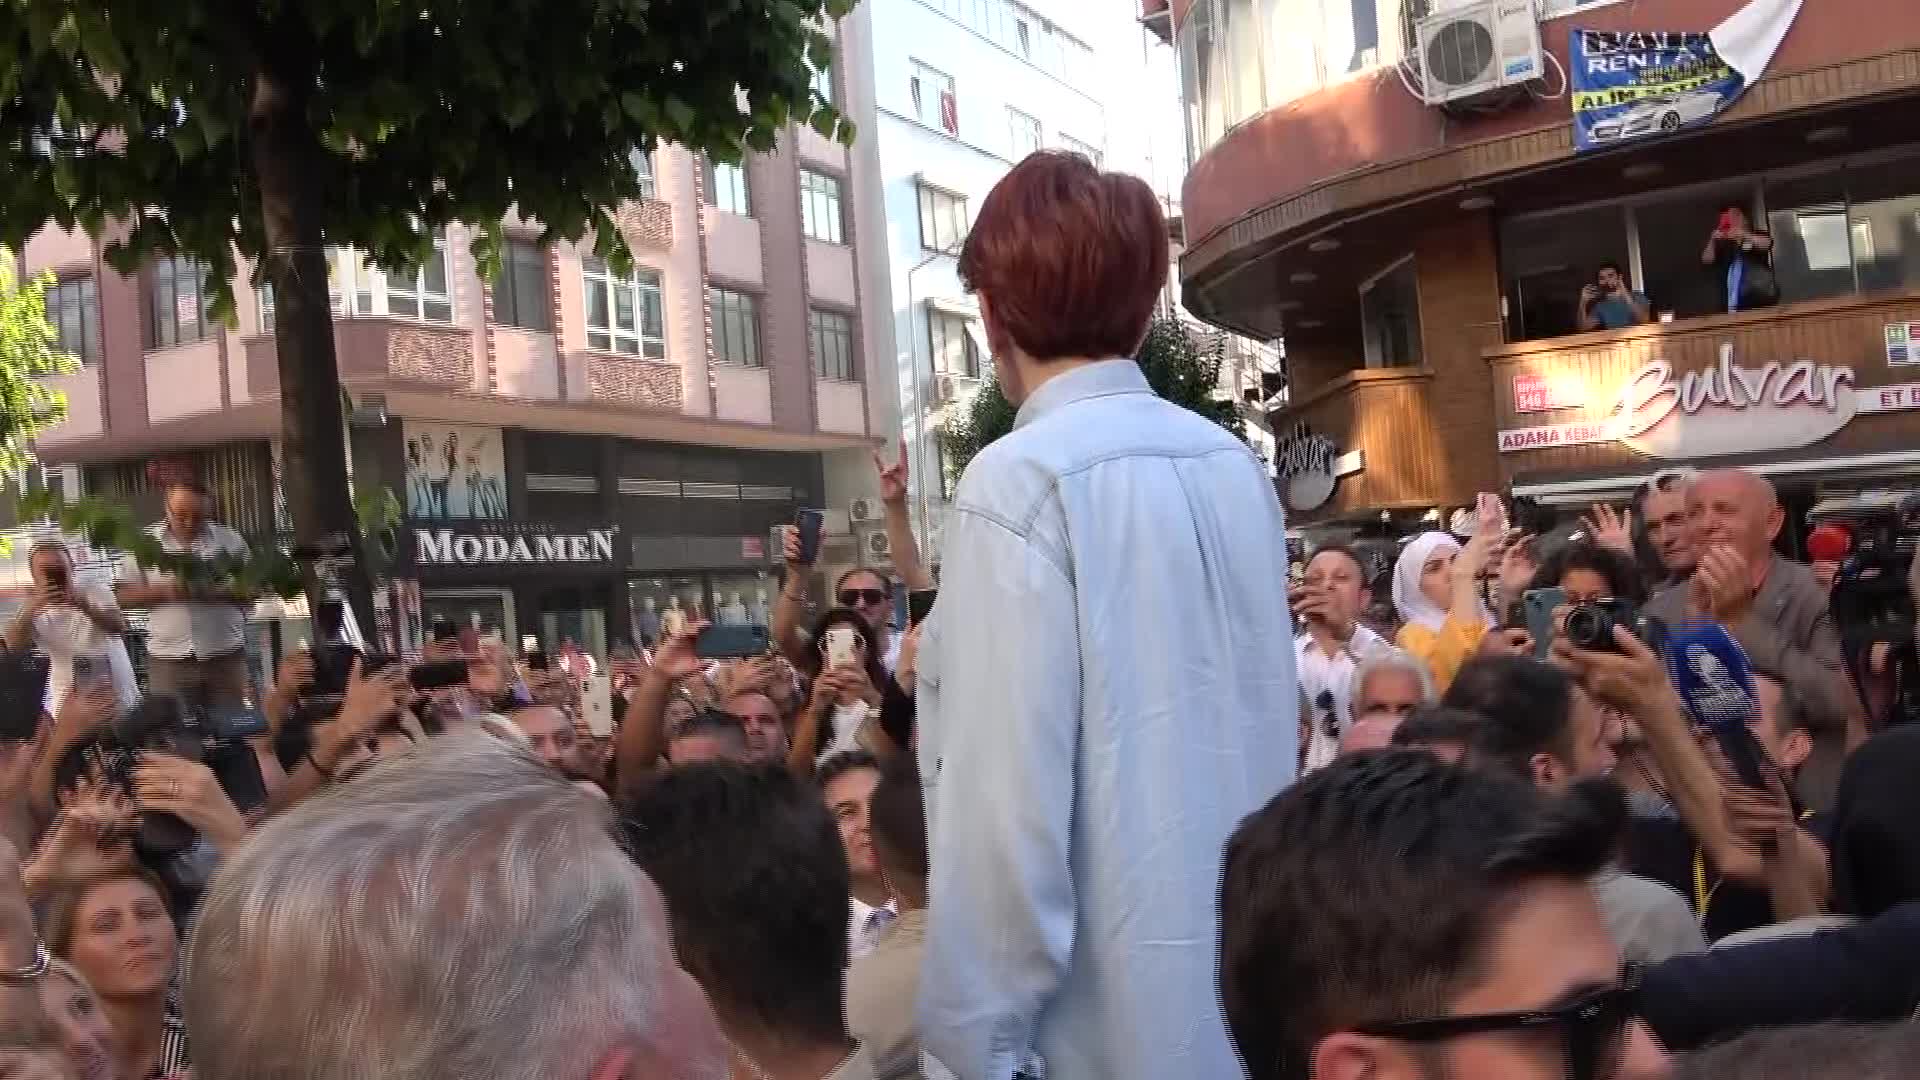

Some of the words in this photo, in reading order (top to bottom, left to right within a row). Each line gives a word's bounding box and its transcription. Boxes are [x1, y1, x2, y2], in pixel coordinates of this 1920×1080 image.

[1614, 342, 1855, 438] Bulvar
[1881, 390, 1901, 407] ET
[1503, 430, 1560, 448] ADANA
[415, 528, 614, 564] MODAMEN
